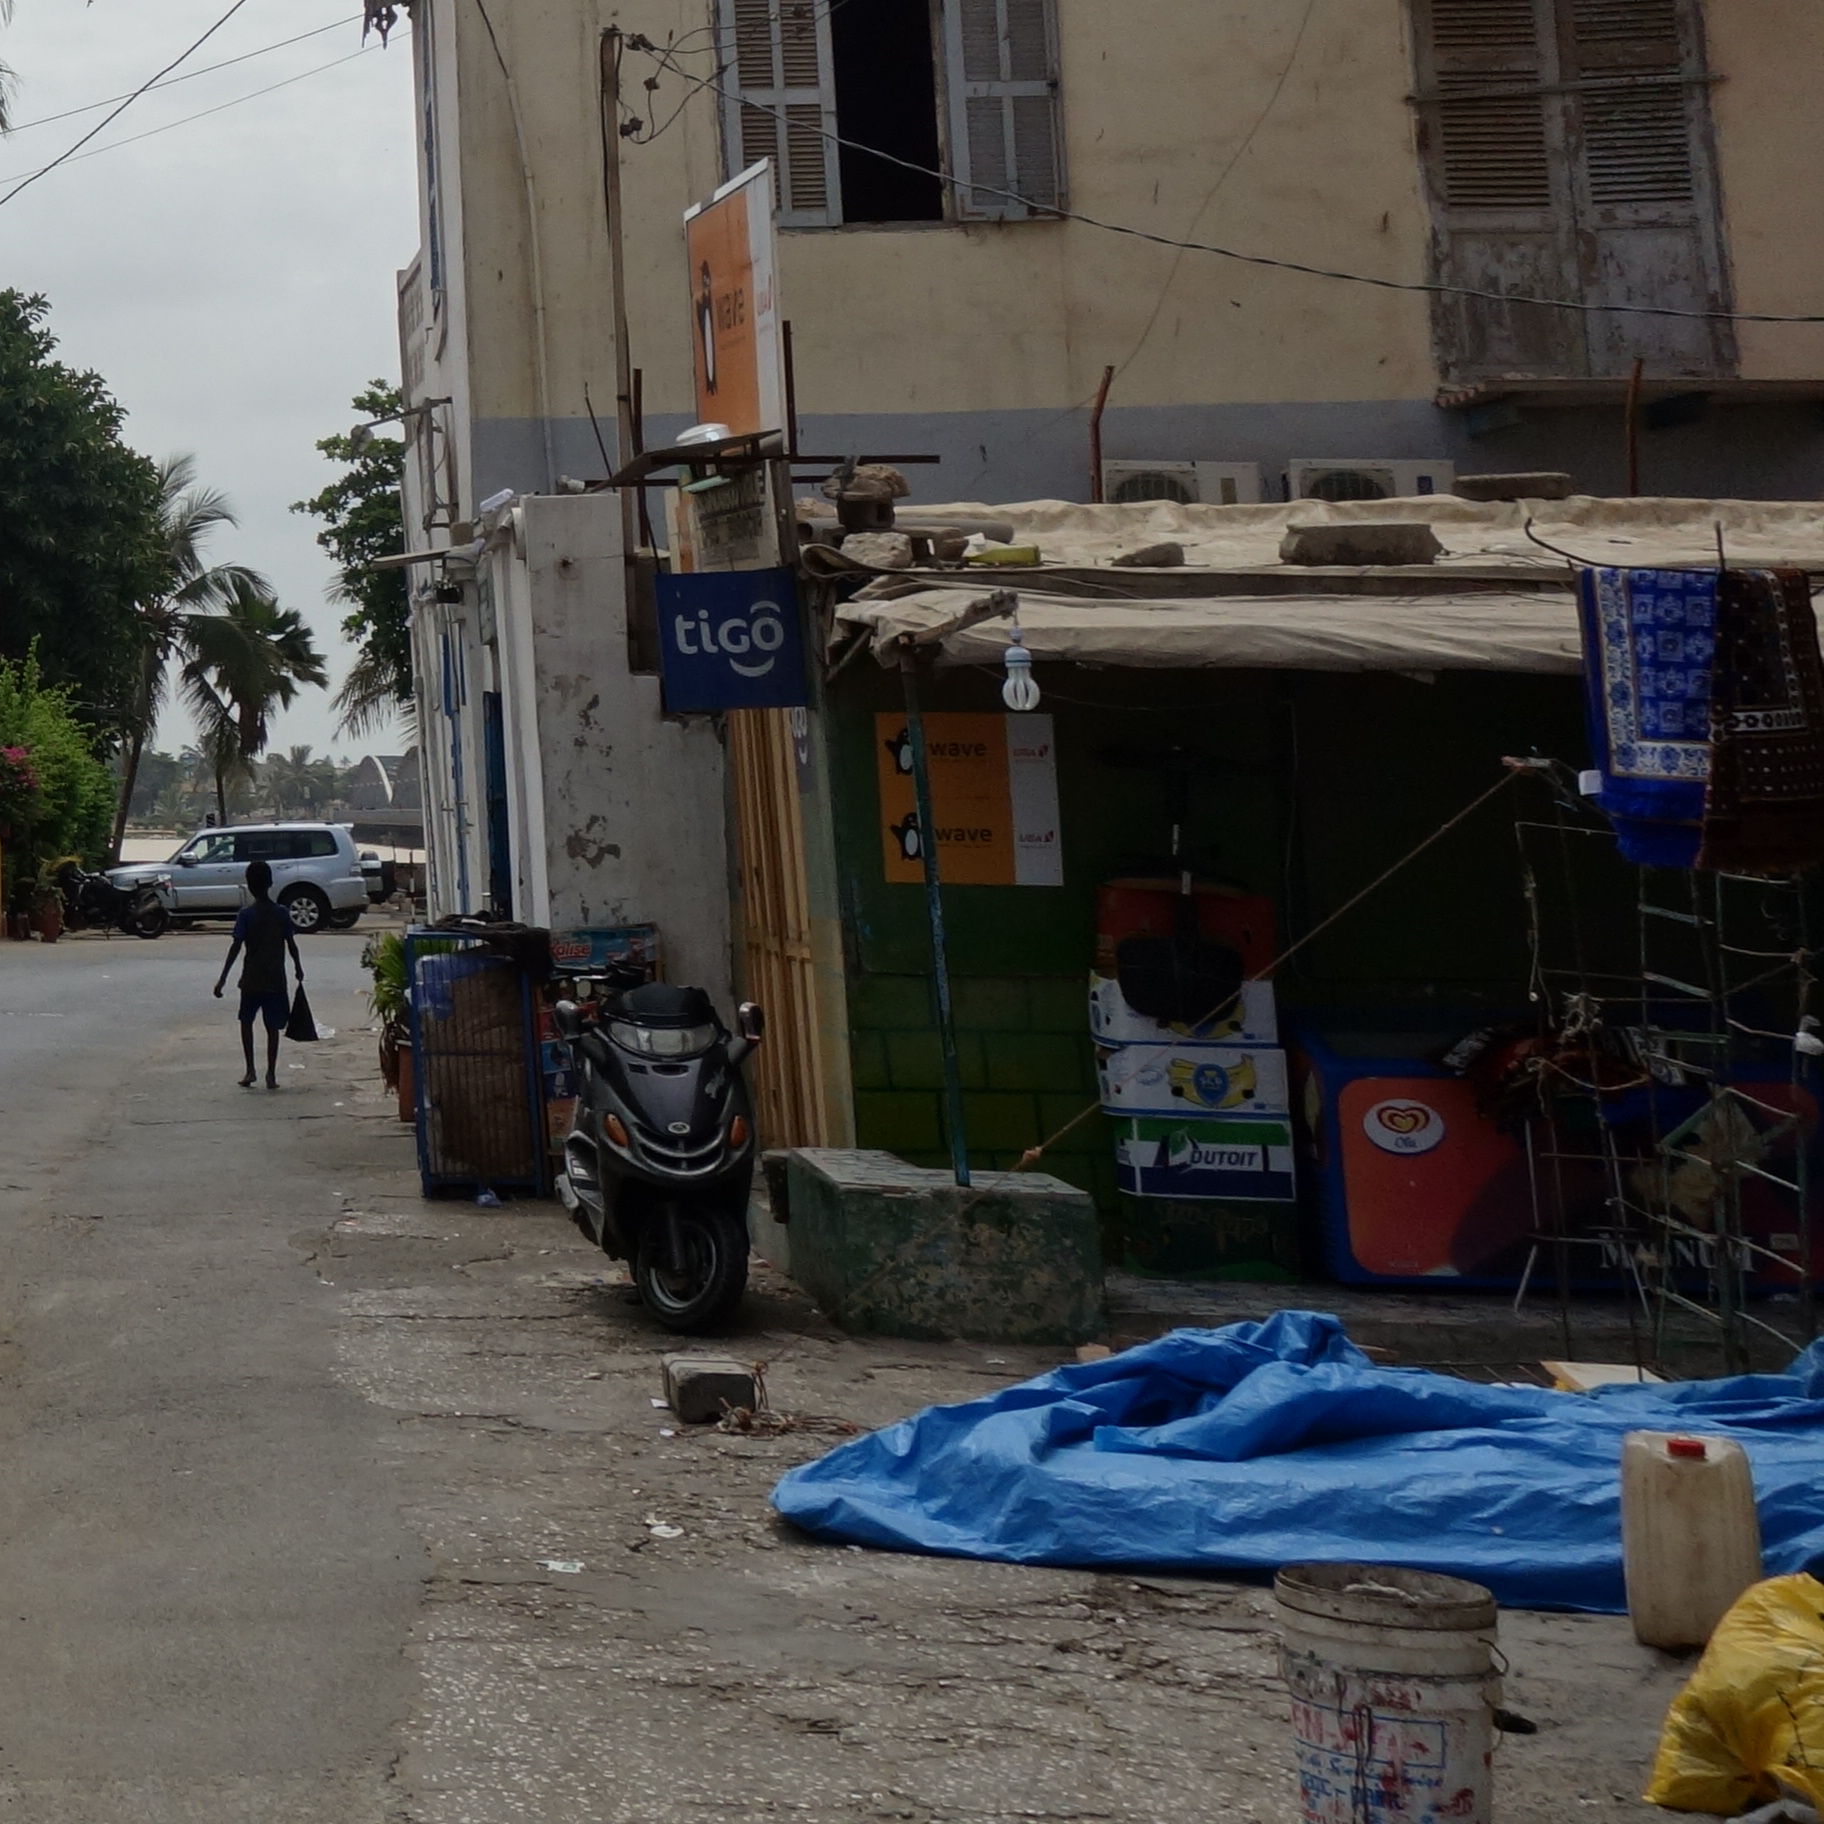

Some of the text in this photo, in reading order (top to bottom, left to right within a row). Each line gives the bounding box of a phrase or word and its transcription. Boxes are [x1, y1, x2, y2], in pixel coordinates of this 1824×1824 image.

[929, 742, 987, 757] wave
[935, 828, 993, 842] wave
[1190, 1151, 1259, 1167] DUTOIT
[1596, 1232, 1757, 1273] MNUM
